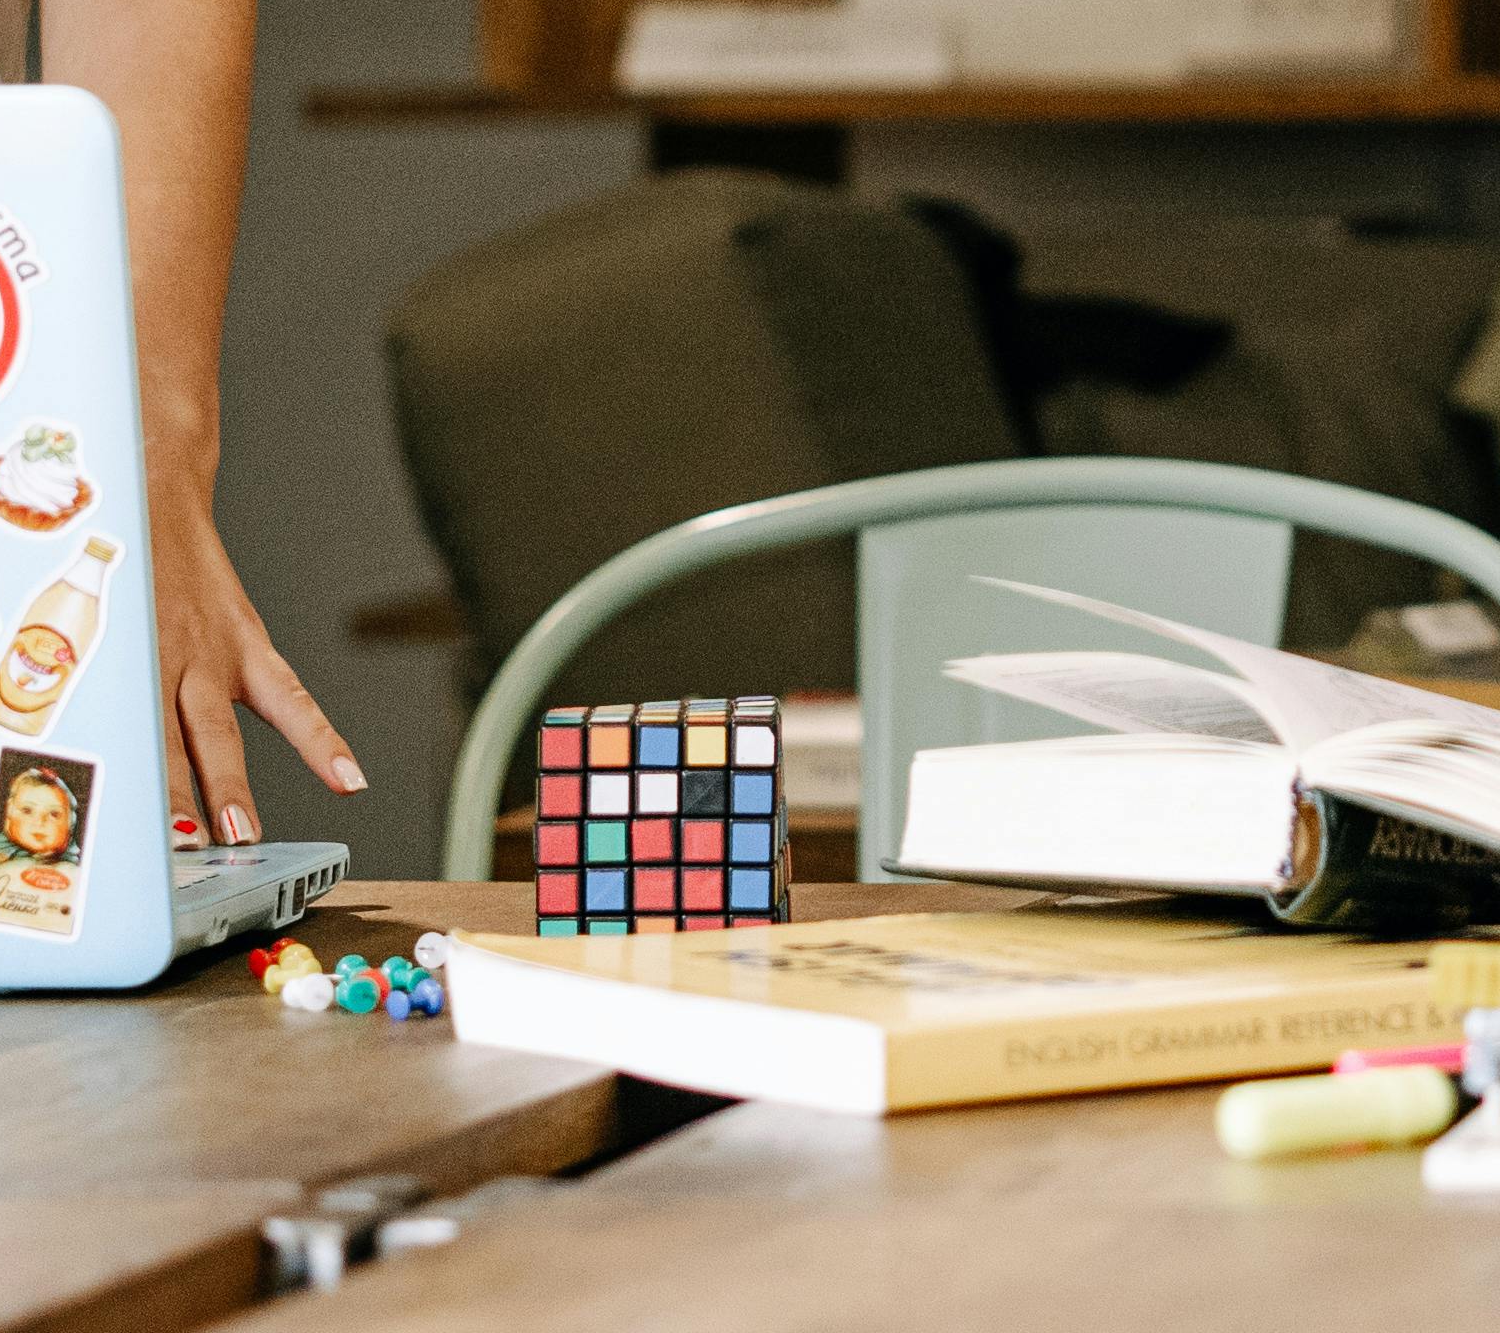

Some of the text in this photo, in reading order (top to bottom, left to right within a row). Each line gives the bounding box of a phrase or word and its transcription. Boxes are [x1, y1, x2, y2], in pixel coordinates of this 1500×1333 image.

[1002, 1033, 1121, 1068] ENGLISH
[1124, 1018, 1267, 1057] GRAMMAR
[1277, 1002, 1416, 1045] REFERENCE
